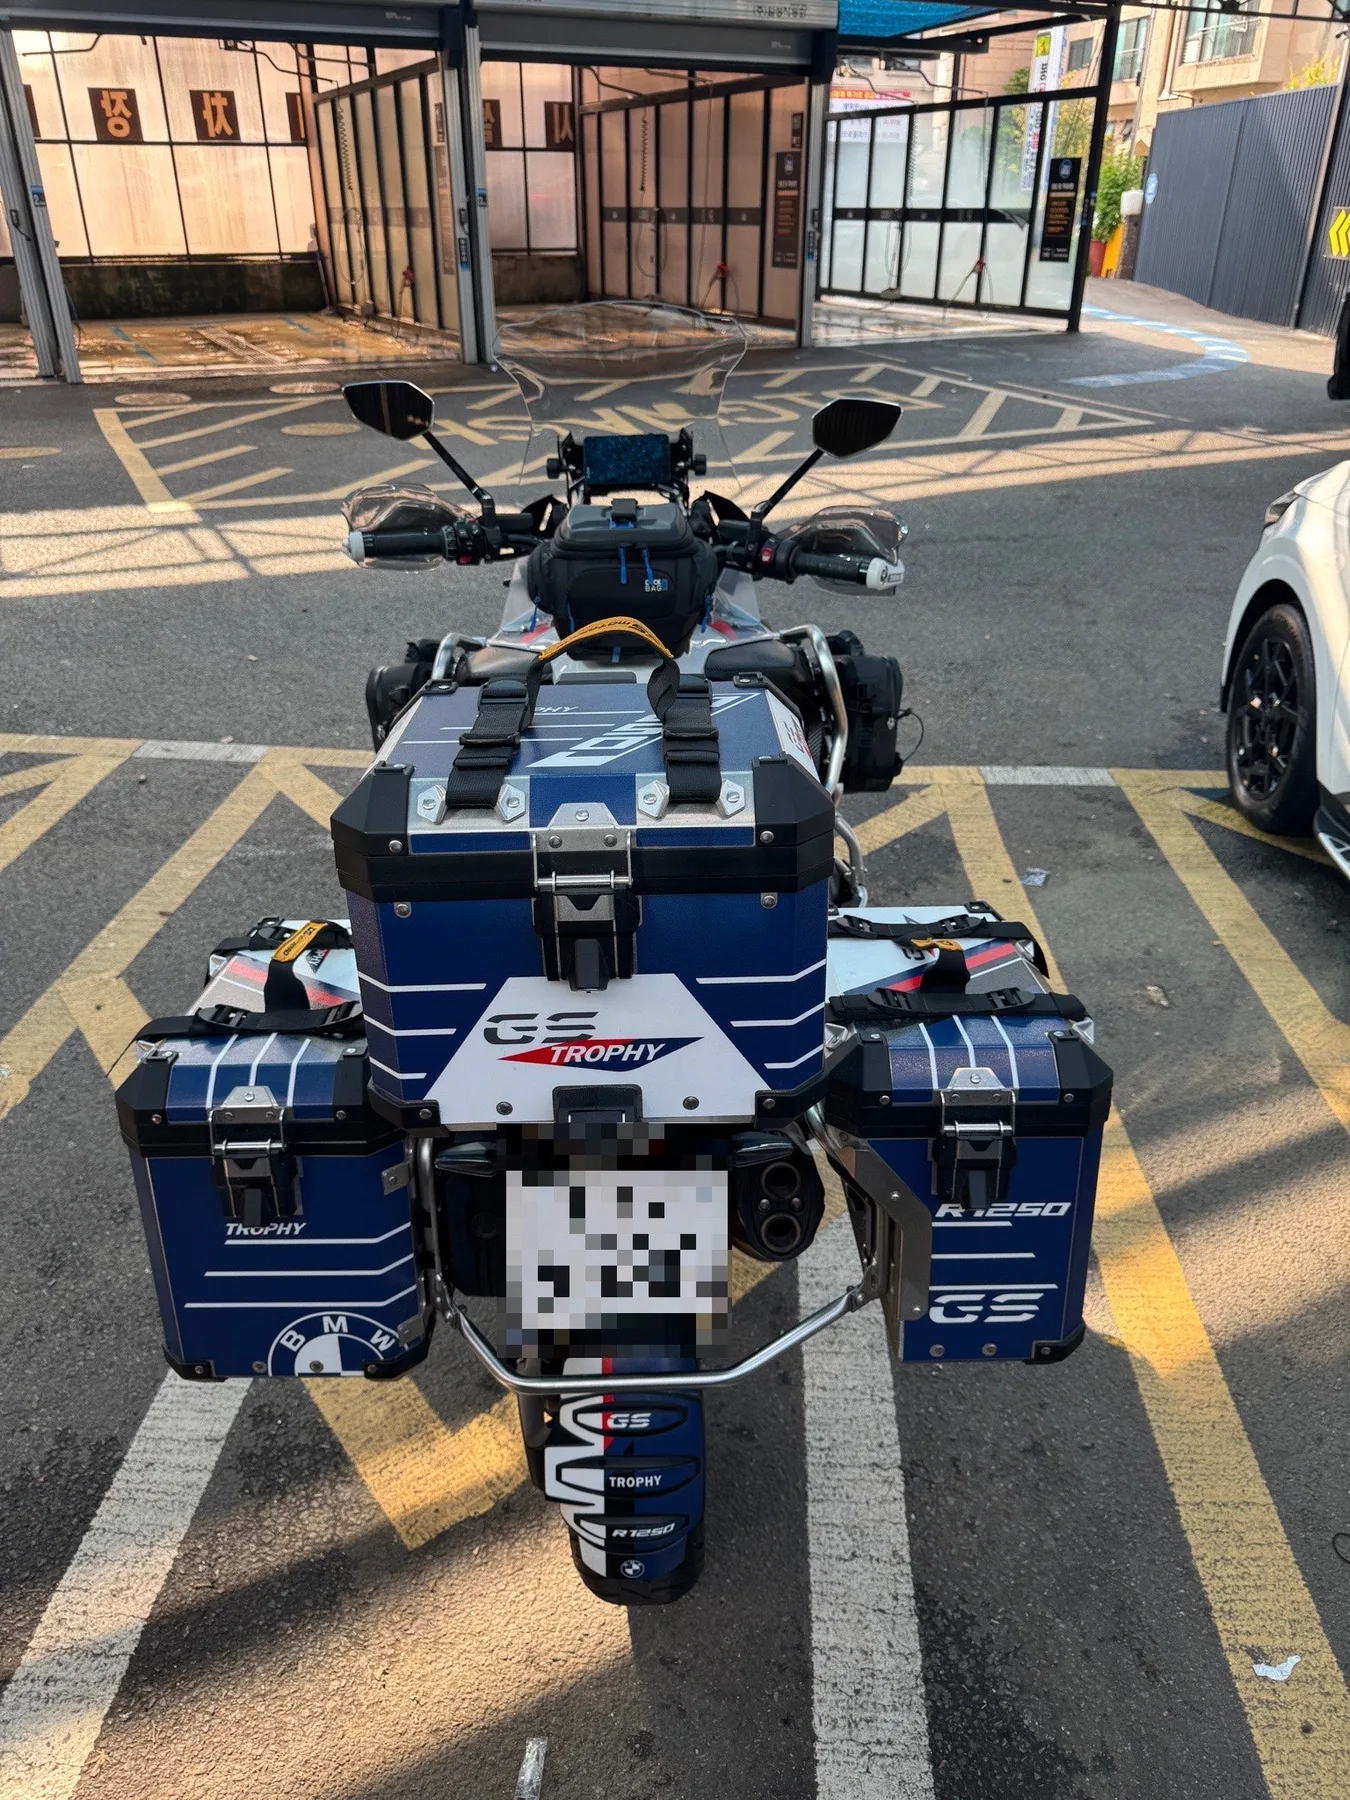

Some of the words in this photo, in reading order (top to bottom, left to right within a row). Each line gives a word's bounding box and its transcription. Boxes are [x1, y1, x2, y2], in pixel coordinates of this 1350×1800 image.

[483, 1011, 599, 1045] GS
[550, 1043, 666, 1064] TROPHY
[225, 1222, 308, 1236] TROPHY
[928, 1292, 1045, 1324] GS
[279, 1315, 397, 1352] BMW
[606, 1412, 651, 1429] GS
[609, 1474, 663, 1488] TROPHY
